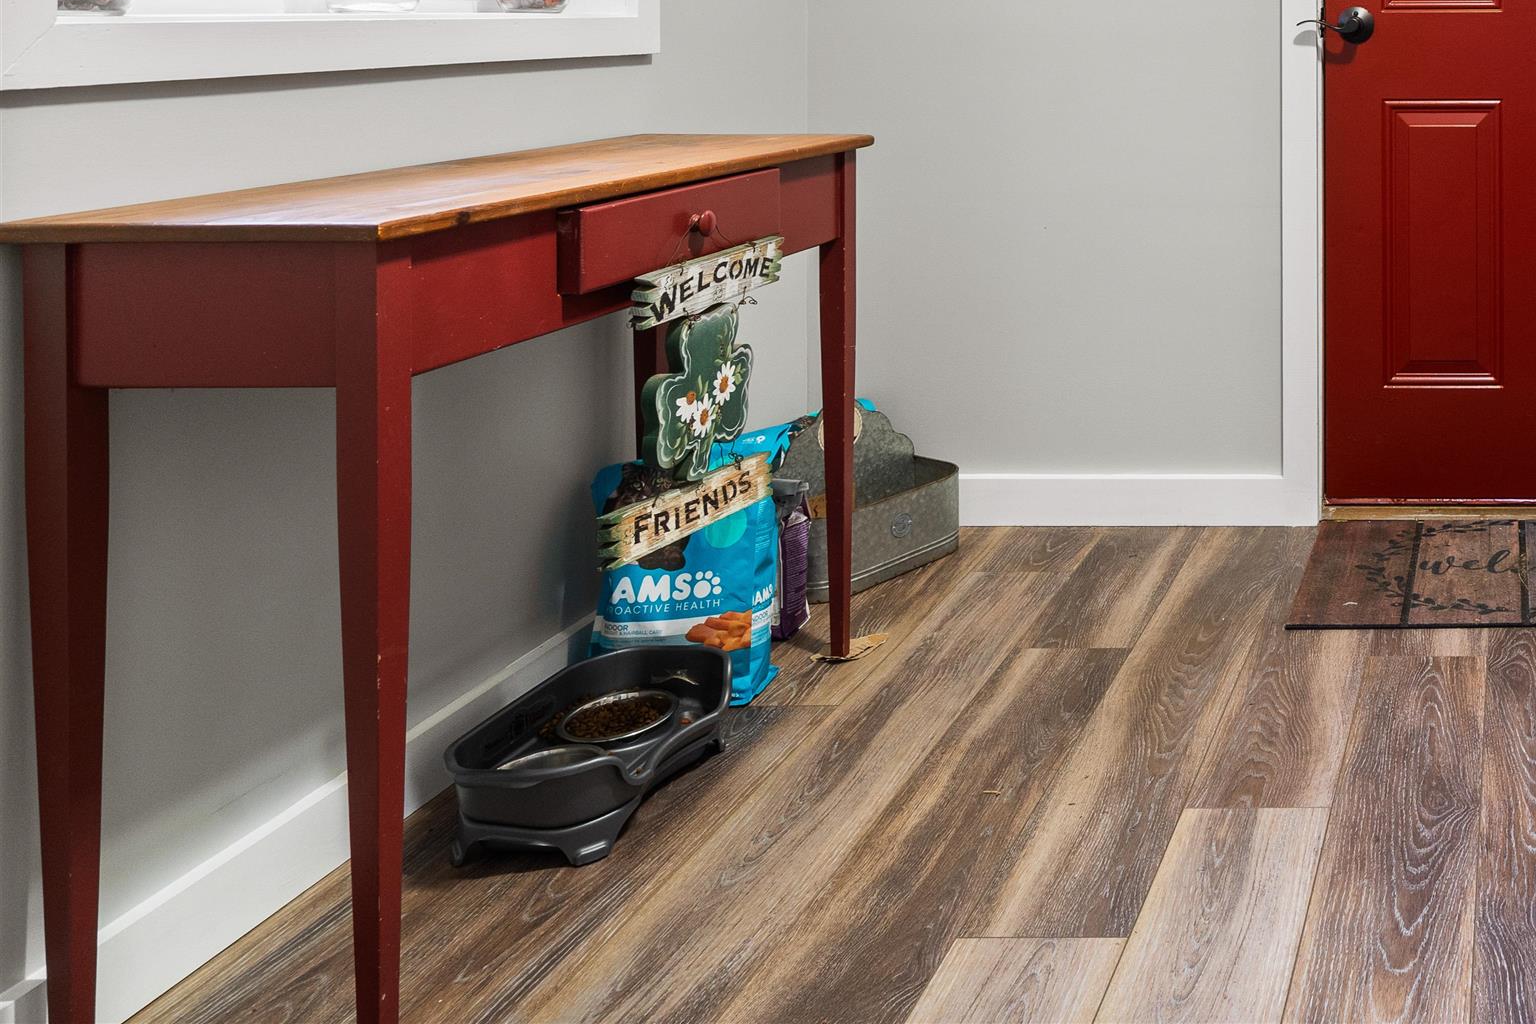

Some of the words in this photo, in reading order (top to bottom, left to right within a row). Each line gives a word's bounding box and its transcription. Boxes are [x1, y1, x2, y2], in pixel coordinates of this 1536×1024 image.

[650, 257, 774, 322] WELCOME
[609, 574, 693, 605] AMS
[607, 604, 670, 616] ROACTIVE
[675, 598, 721, 611] HEALTH
